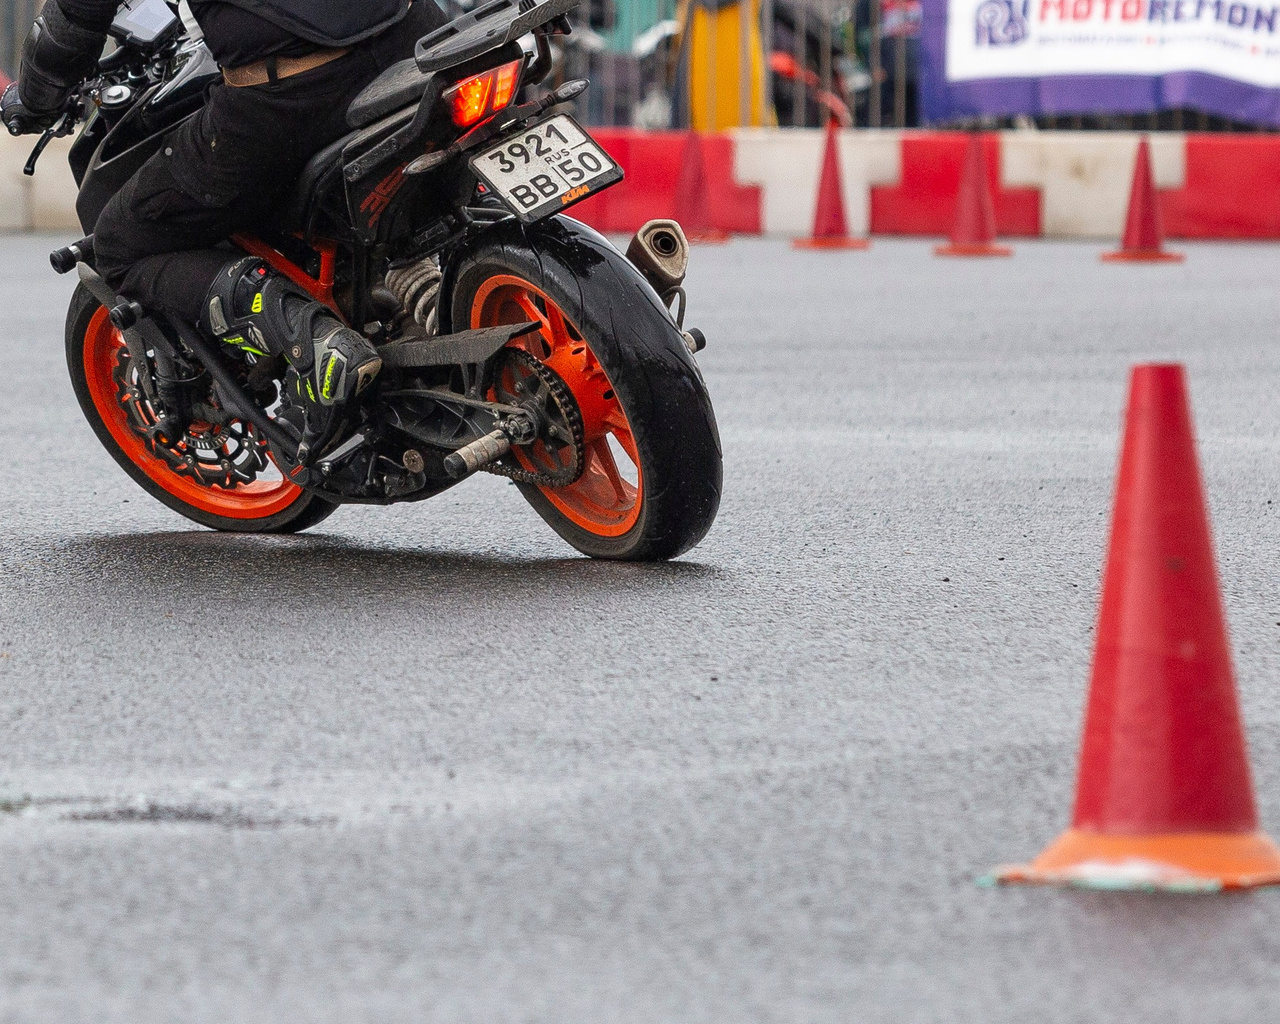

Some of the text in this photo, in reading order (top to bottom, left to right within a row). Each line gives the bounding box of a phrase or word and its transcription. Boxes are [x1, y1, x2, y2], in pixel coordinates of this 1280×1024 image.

[488, 123, 569, 174] 3921
[545, 148, 570, 166] RUS
[557, 151, 603, 183] 50
[561, 184, 590, 205] KTM
